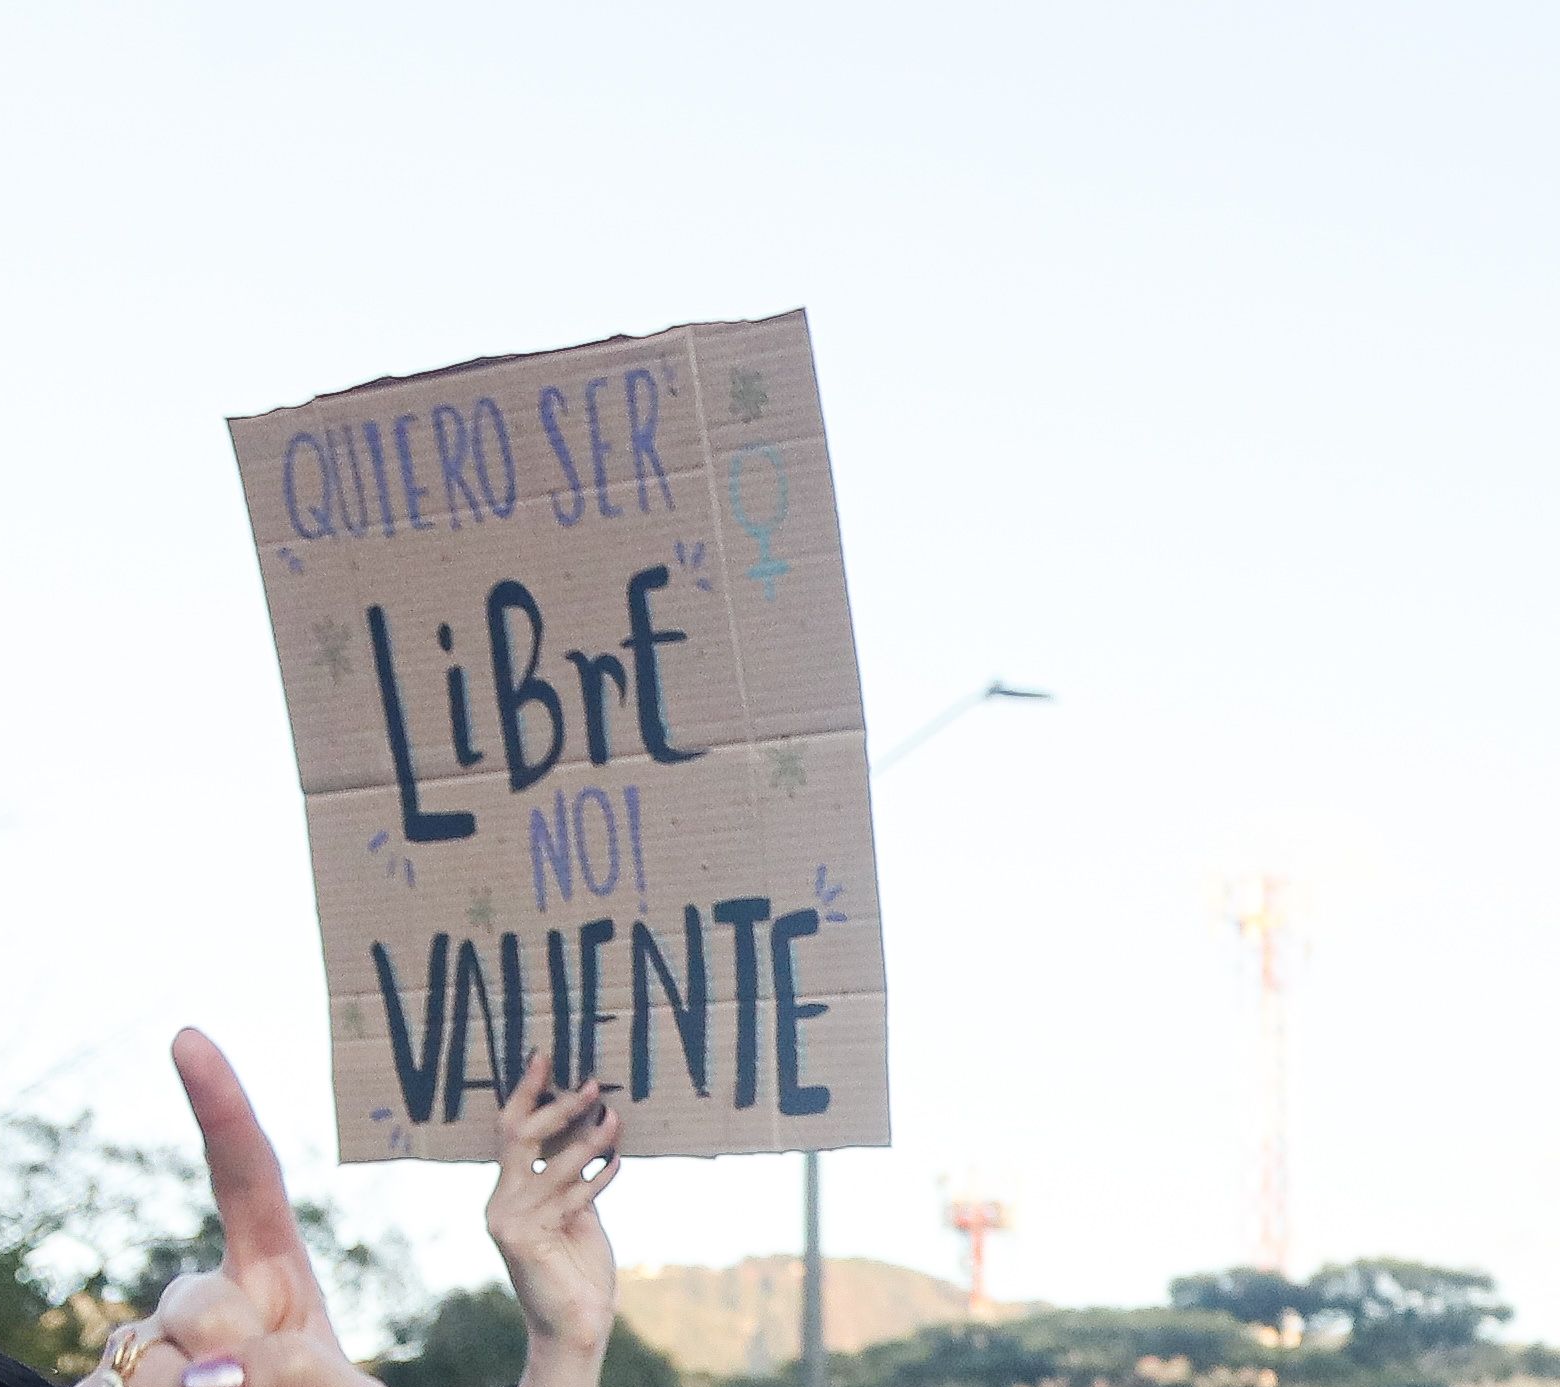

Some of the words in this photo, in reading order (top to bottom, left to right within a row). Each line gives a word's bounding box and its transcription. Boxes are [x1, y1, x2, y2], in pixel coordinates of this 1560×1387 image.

[282, 397, 517, 540] QUIERO
[539, 368, 678, 526] SER
[528, 785, 649, 913] NO!
[371, 897, 830, 1123] VALIENTE
